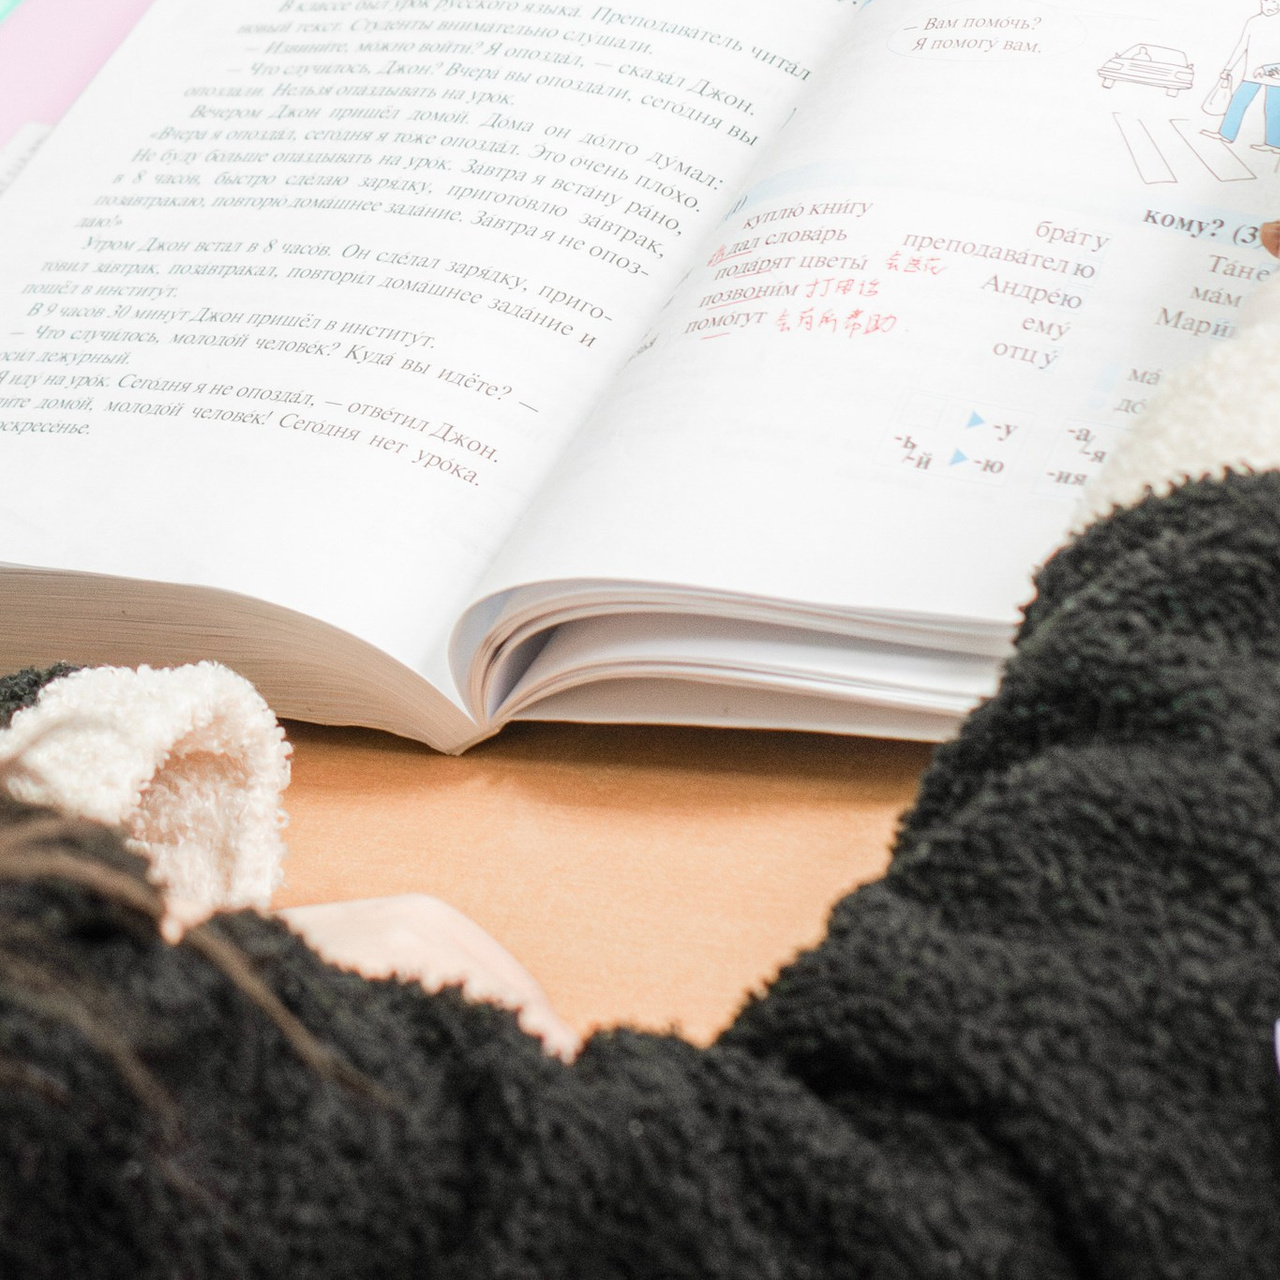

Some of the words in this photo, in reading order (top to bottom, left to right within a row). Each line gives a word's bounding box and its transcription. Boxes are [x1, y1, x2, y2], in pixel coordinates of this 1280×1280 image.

[924, 16, 959, 31] Вам
[912, 37, 928, 52] Я
[1002, 39, 1042, 54] вам.
[483, 42, 503, 55] Я
[686, 79, 753, 115] Джон.
[376, 60, 444, 75] Джон?
[503, 71, 532, 83] вы
[727, 125, 758, 146] вы
[441, 89, 465, 100] на
[267, 104, 322, 119] Джон
[328, 105, 401, 121] пришёл
[544, 126, 571, 138] он
[377, 154, 402, 166] на
[531, 175, 546, 185] я
[1142, 209, 1226, 238] кому?
[539, 230, 555, 241] я
[558, 235, 585, 250] не
[589, 246, 648, 275] опоз-
[726, 235, 760, 257] дал
[136, 237, 191, 252] Джон
[193, 241, 243, 252] встал
[246, 242, 259, 252] в
[263, 239, 278, 252] 8
[342, 244, 371, 259] Он
[538, 285, 612, 321] приго-
[108, 304, 132, 318] 30
[188, 307, 244, 323] Джон
[246, 313, 321, 328] пришёл
[324, 320, 337, 330] в
[579, 333, 596, 347] и
[400, 359, 431, 374] вы
[437, 368, 512, 396] идёте?
[192, 383, 208, 393] я
[208, 384, 233, 395] не
[428, 422, 497, 462] Джон.
[369, 435, 408, 453] нет
